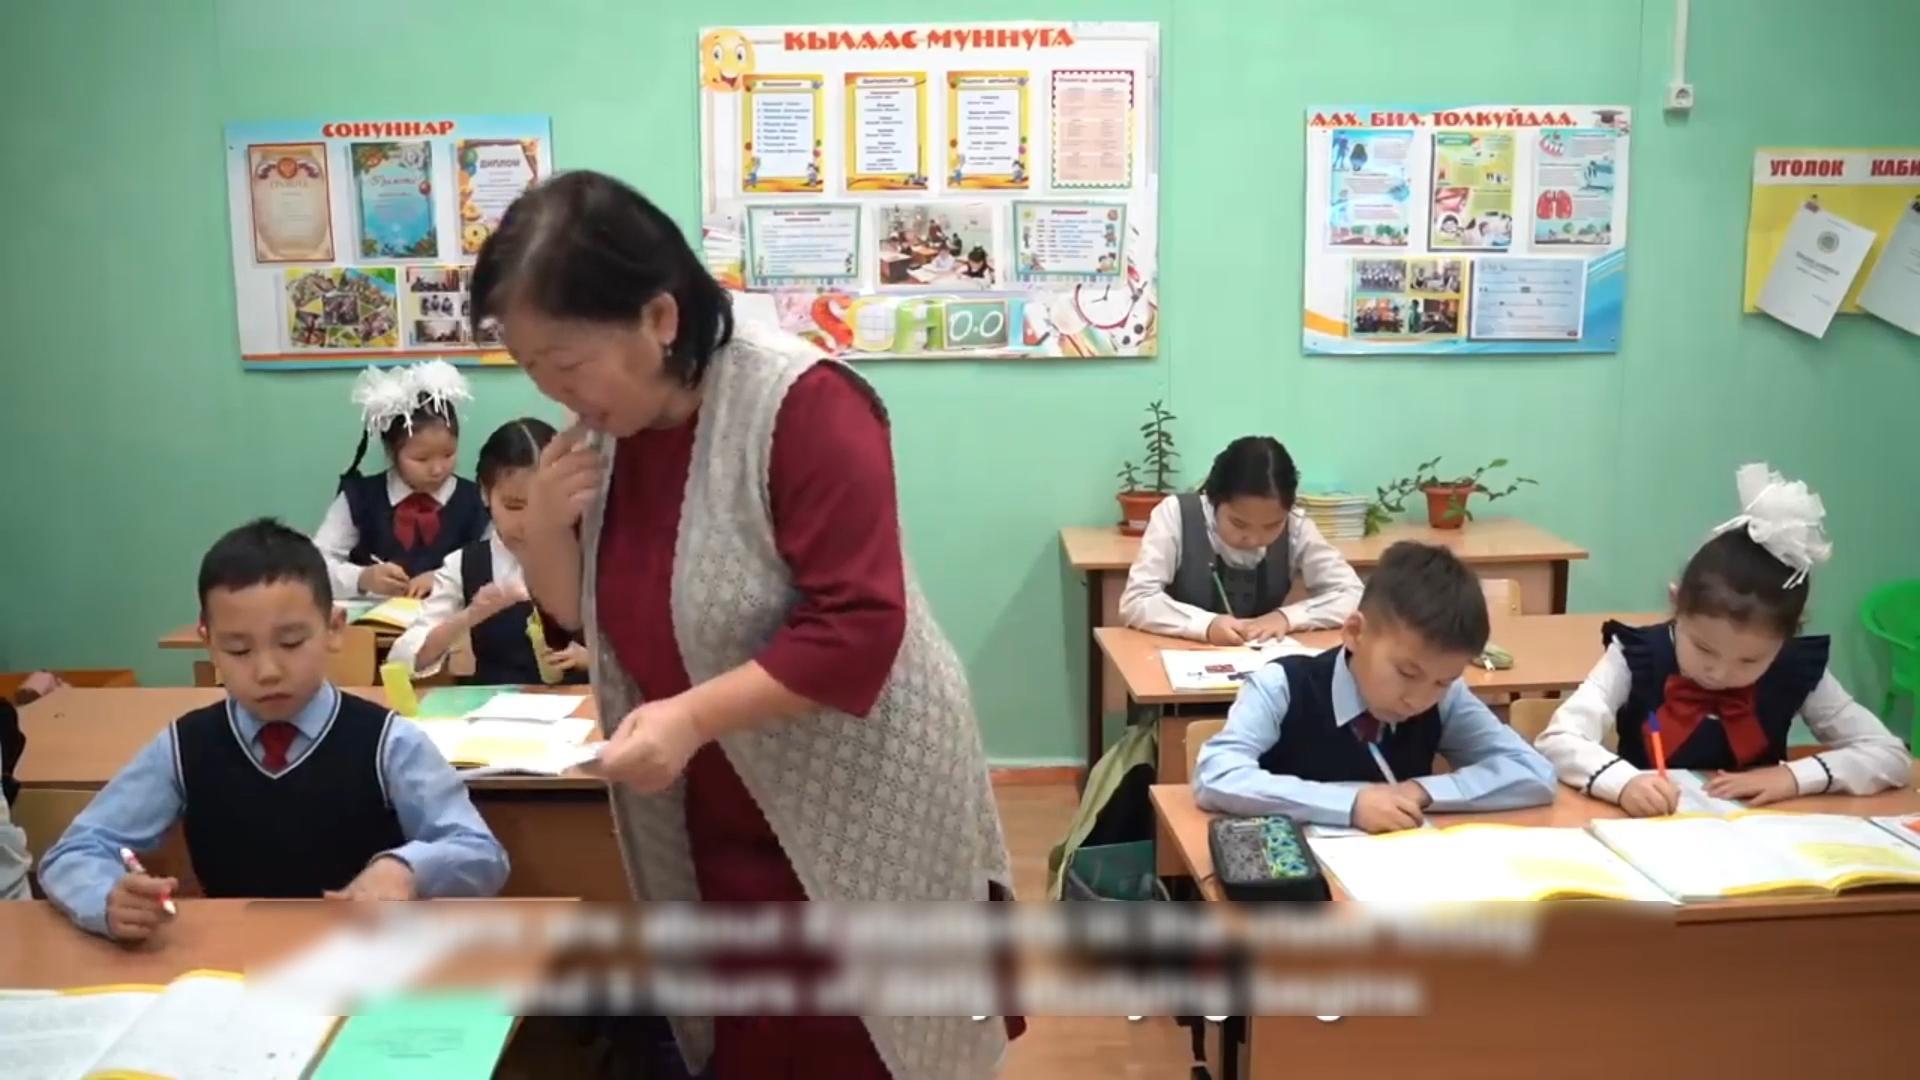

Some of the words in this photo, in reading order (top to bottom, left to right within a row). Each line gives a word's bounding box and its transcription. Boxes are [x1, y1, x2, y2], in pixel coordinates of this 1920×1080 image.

[928, 28, 1075, 51] МУННУГА
[322, 120, 455, 139] СОНУННАР
[1770, 159, 1844, 177] УГОЛОК
